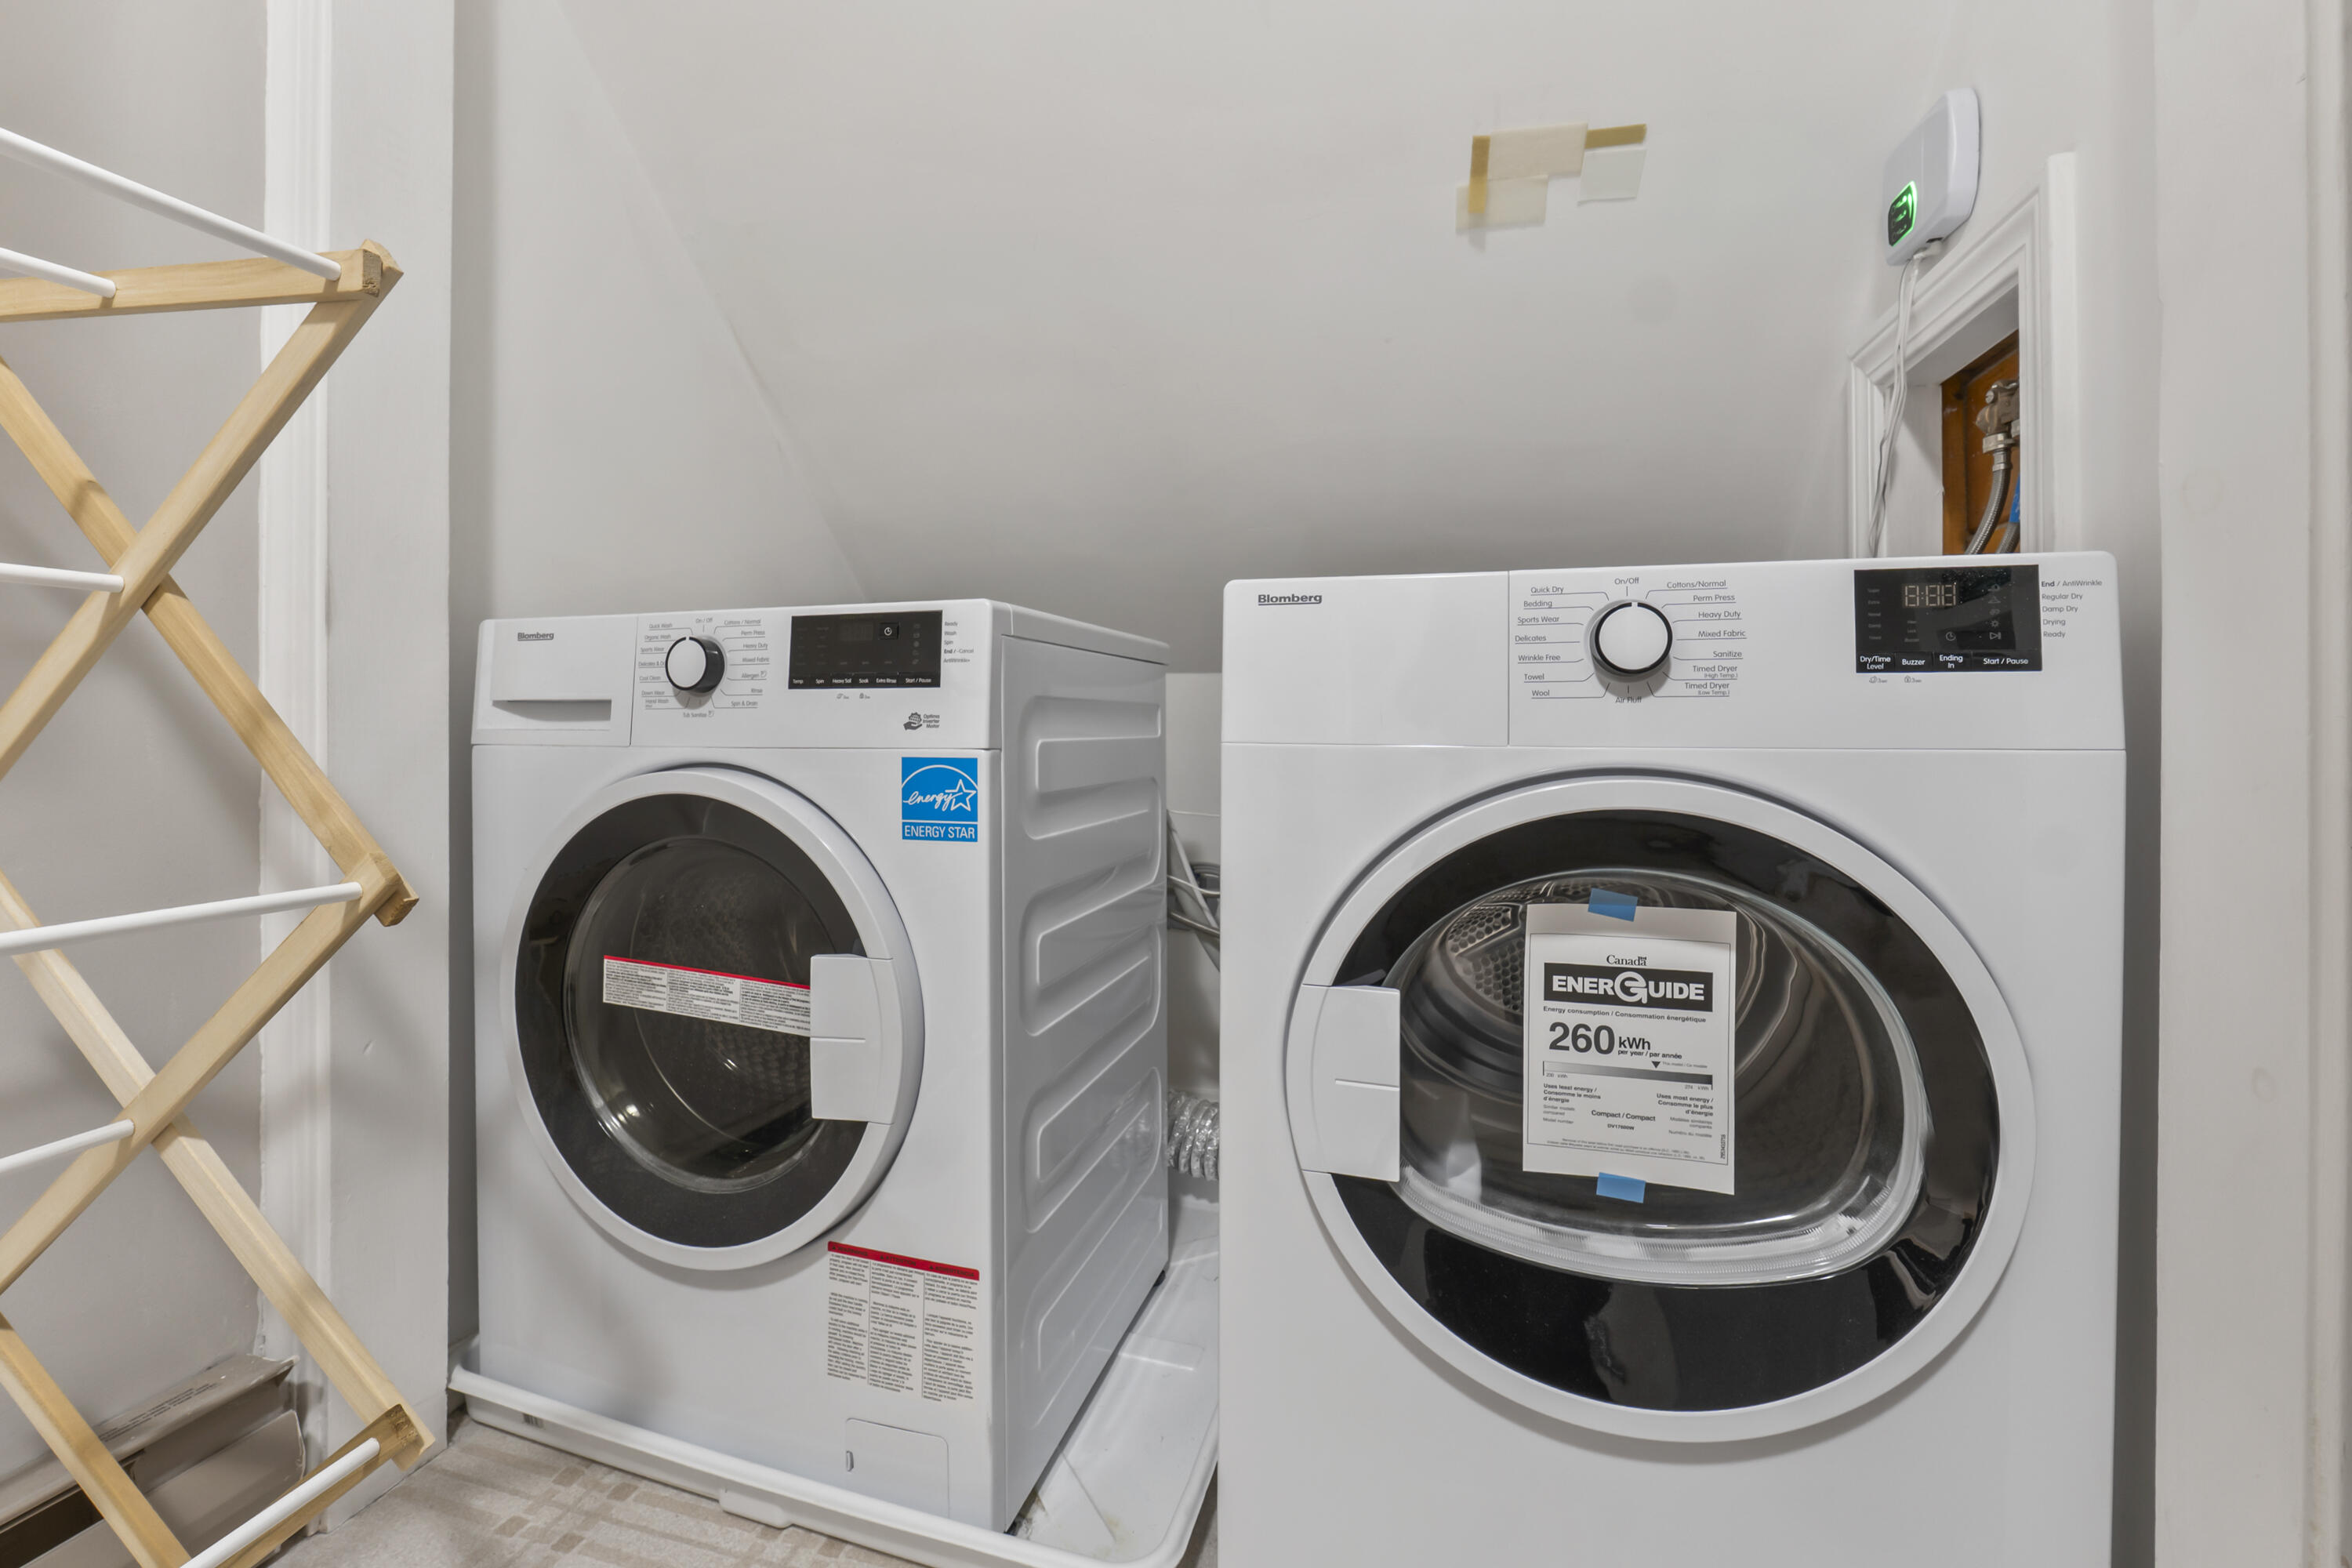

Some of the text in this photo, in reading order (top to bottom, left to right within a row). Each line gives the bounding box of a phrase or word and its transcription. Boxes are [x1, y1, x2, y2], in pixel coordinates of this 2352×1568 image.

[1667, 579, 1726, 589] Cottons/Normal
[1552, 586, 1564, 594] Dry
[1258, 593, 1323, 606] Blomberg
[2042, 593, 2069, 601] Regular
[1523, 600, 1552, 608] Bedding
[1698, 611, 1741, 620] Heavy Duty
[1517, 616, 1540, 625] Sports
[517, 632, 554, 641] Blomberg
[1939, 655, 1963, 664] Ending
[1718, 665, 1738, 673] Dryer
[903, 791, 955, 811] energy
[905, 826, 975, 839] ENERGY STAR
[1606, 954, 1647, 967] Canada
[1543, 1006, 1566, 1014] Energy
[1615, 1011, 1664, 1020] Consommation
[1666, 1014, 1707, 1023] énergétique
[1548, 1022, 1651, 1054] 260 kWh
[1591, 1109, 1621, 1118] Compact
